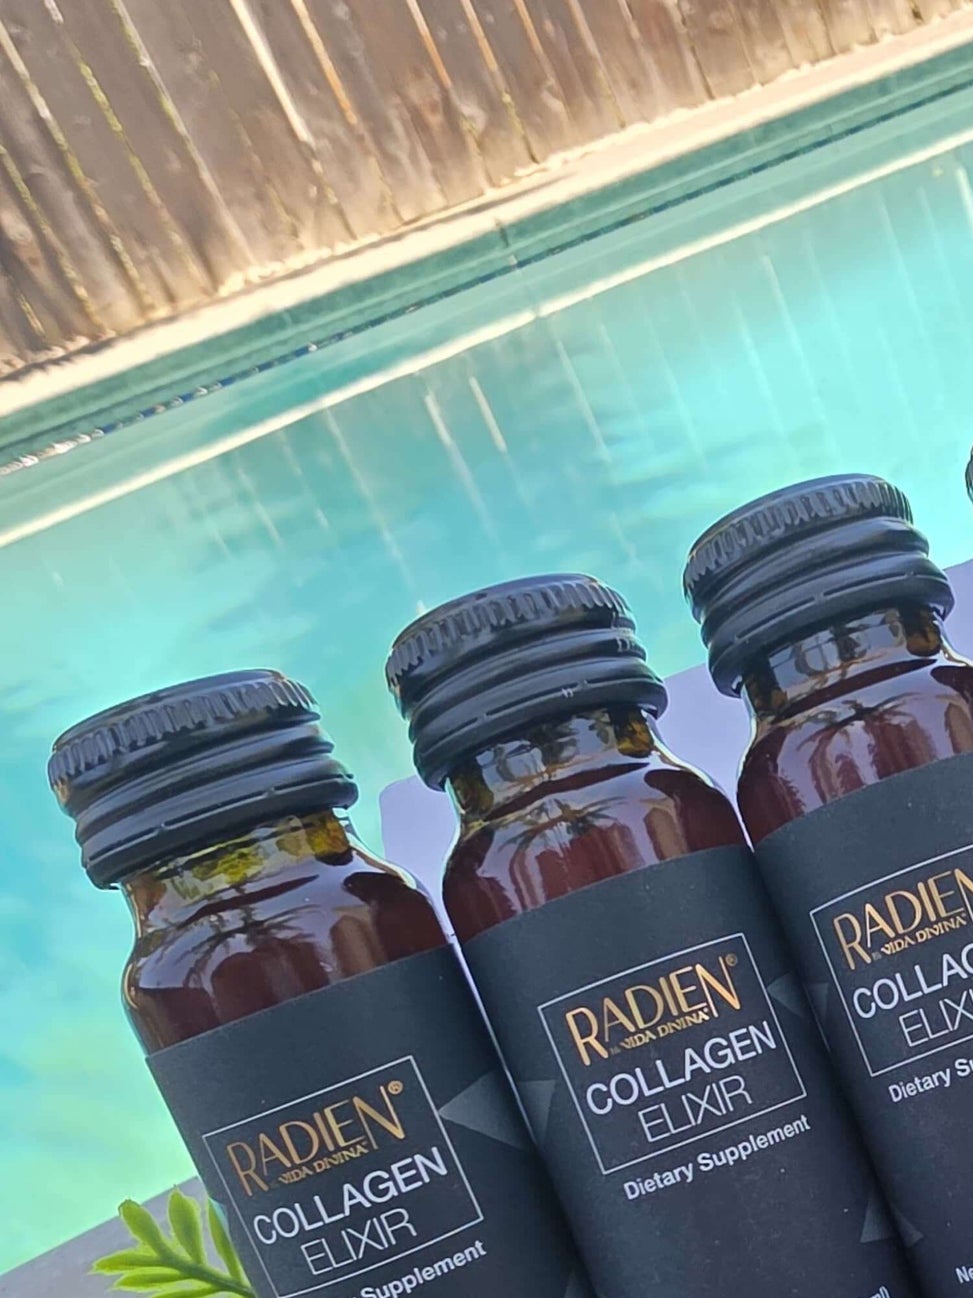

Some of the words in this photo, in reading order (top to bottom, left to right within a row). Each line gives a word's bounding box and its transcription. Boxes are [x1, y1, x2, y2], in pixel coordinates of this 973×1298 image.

[881, 936, 915, 955] VIDA
[586, 1021, 776, 1115] COLLAGEN
[620, 1031, 656, 1049] VIDA
[638, 1074, 752, 1143] ELIXIR
[888, 1069, 951, 1102] Dietary
[278, 1166, 313, 1184] VIDA
[624, 1162, 694, 1200] Dietary
[697, 1114, 811, 1173] Supplement
[253, 1147, 448, 1244] COLLAGEN
[301, 1208, 416, 1276] ELIXIR
